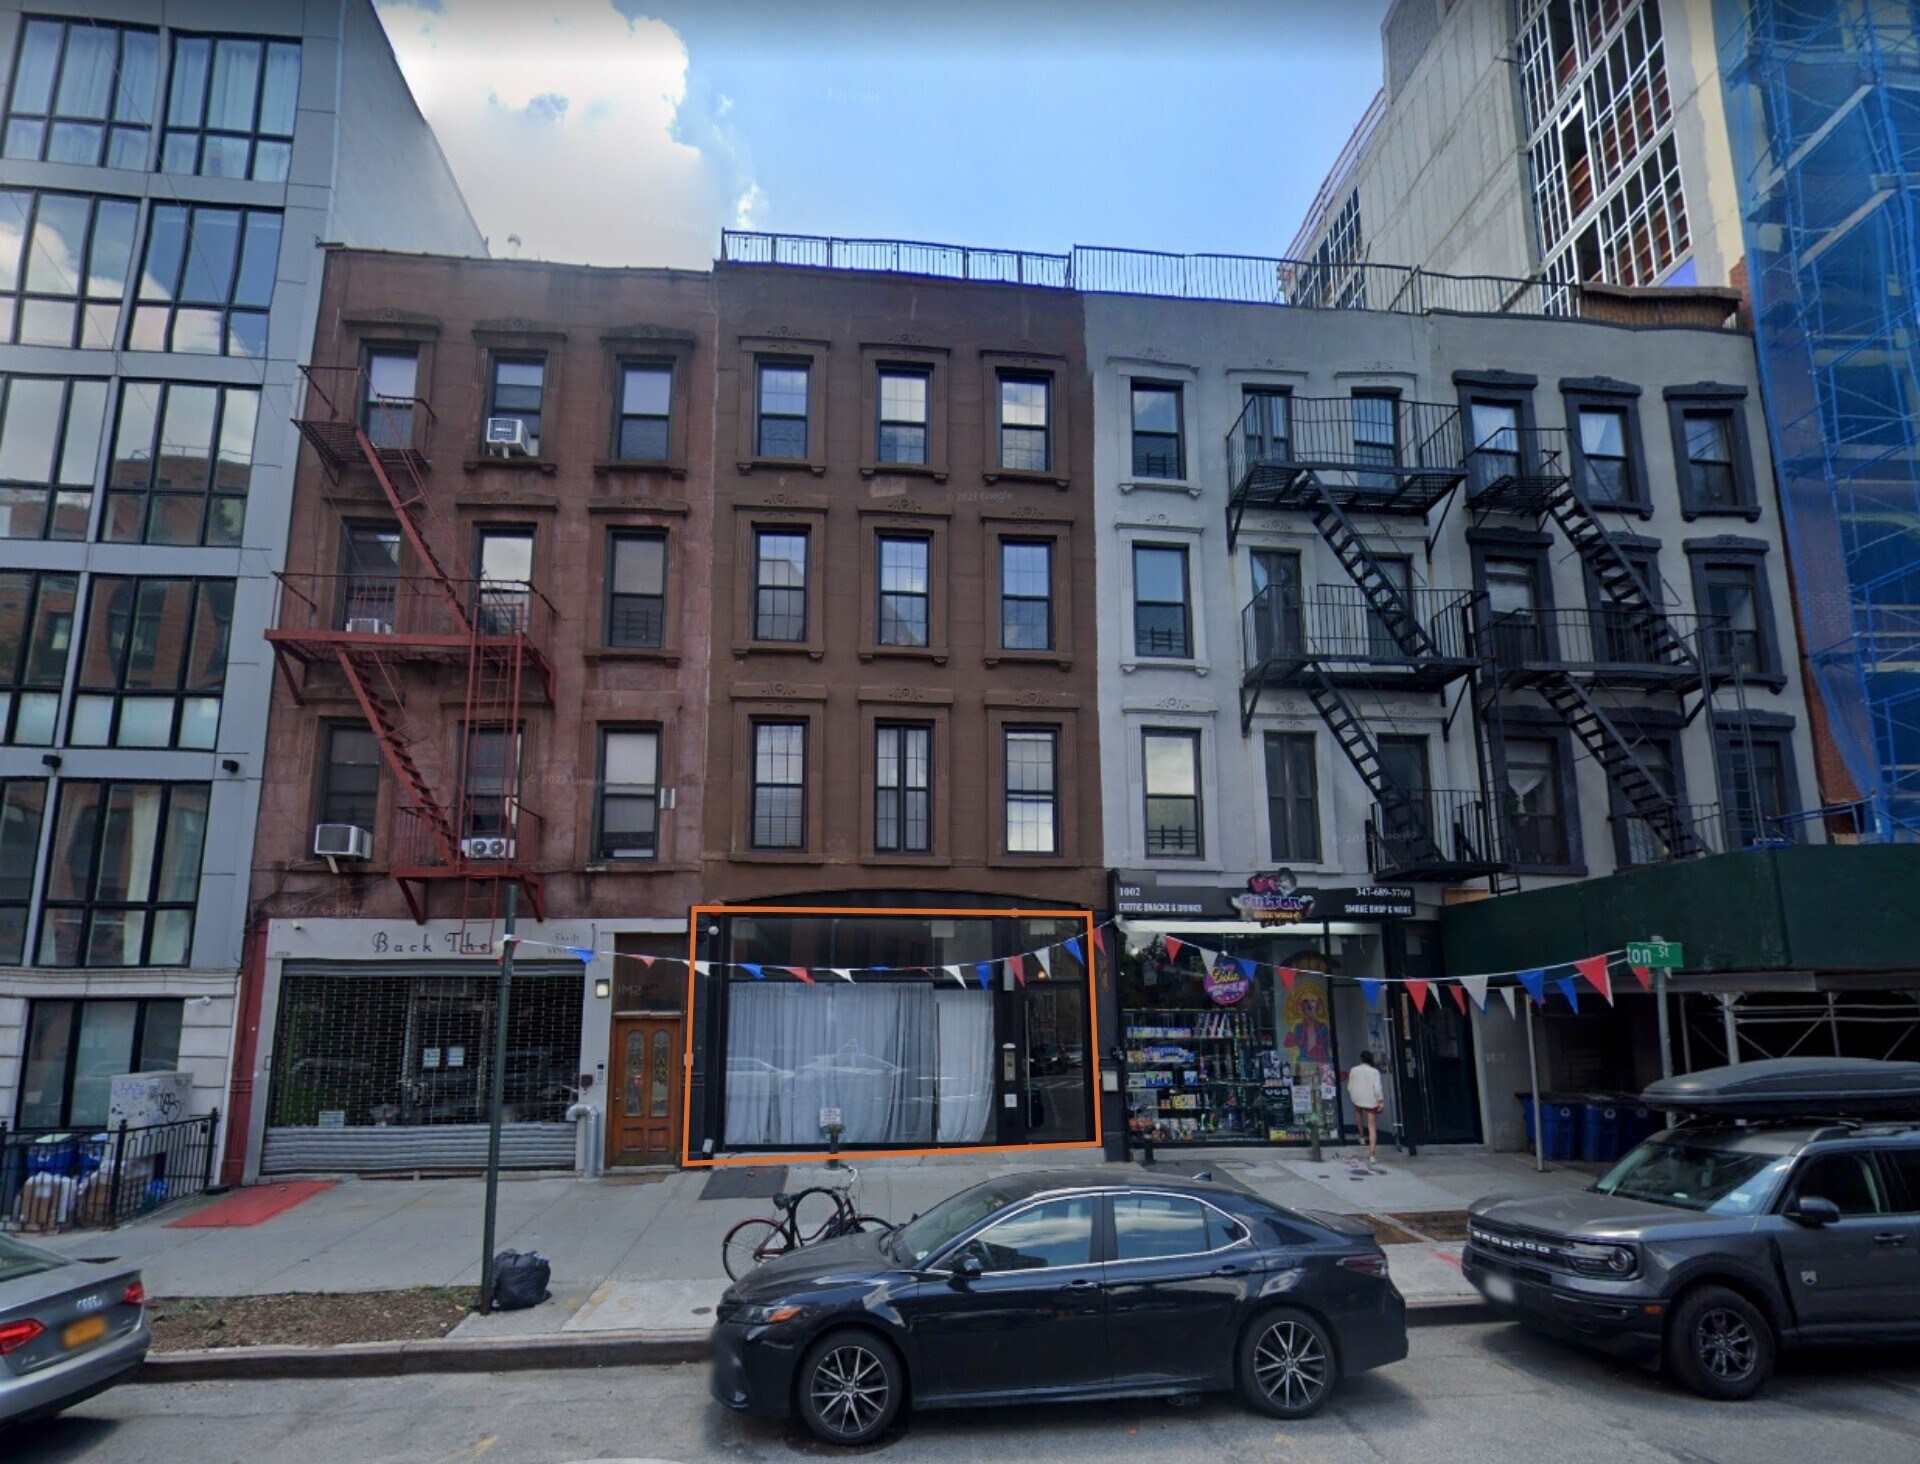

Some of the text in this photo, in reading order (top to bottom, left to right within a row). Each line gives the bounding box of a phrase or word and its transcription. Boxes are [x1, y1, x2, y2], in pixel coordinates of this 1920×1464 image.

[1119, 887, 1141, 897] 1002
[1119, 902, 1143, 912] EXOTIC
[371, 931, 497, 953] Back The
[1658, 946, 1669, 958] St
